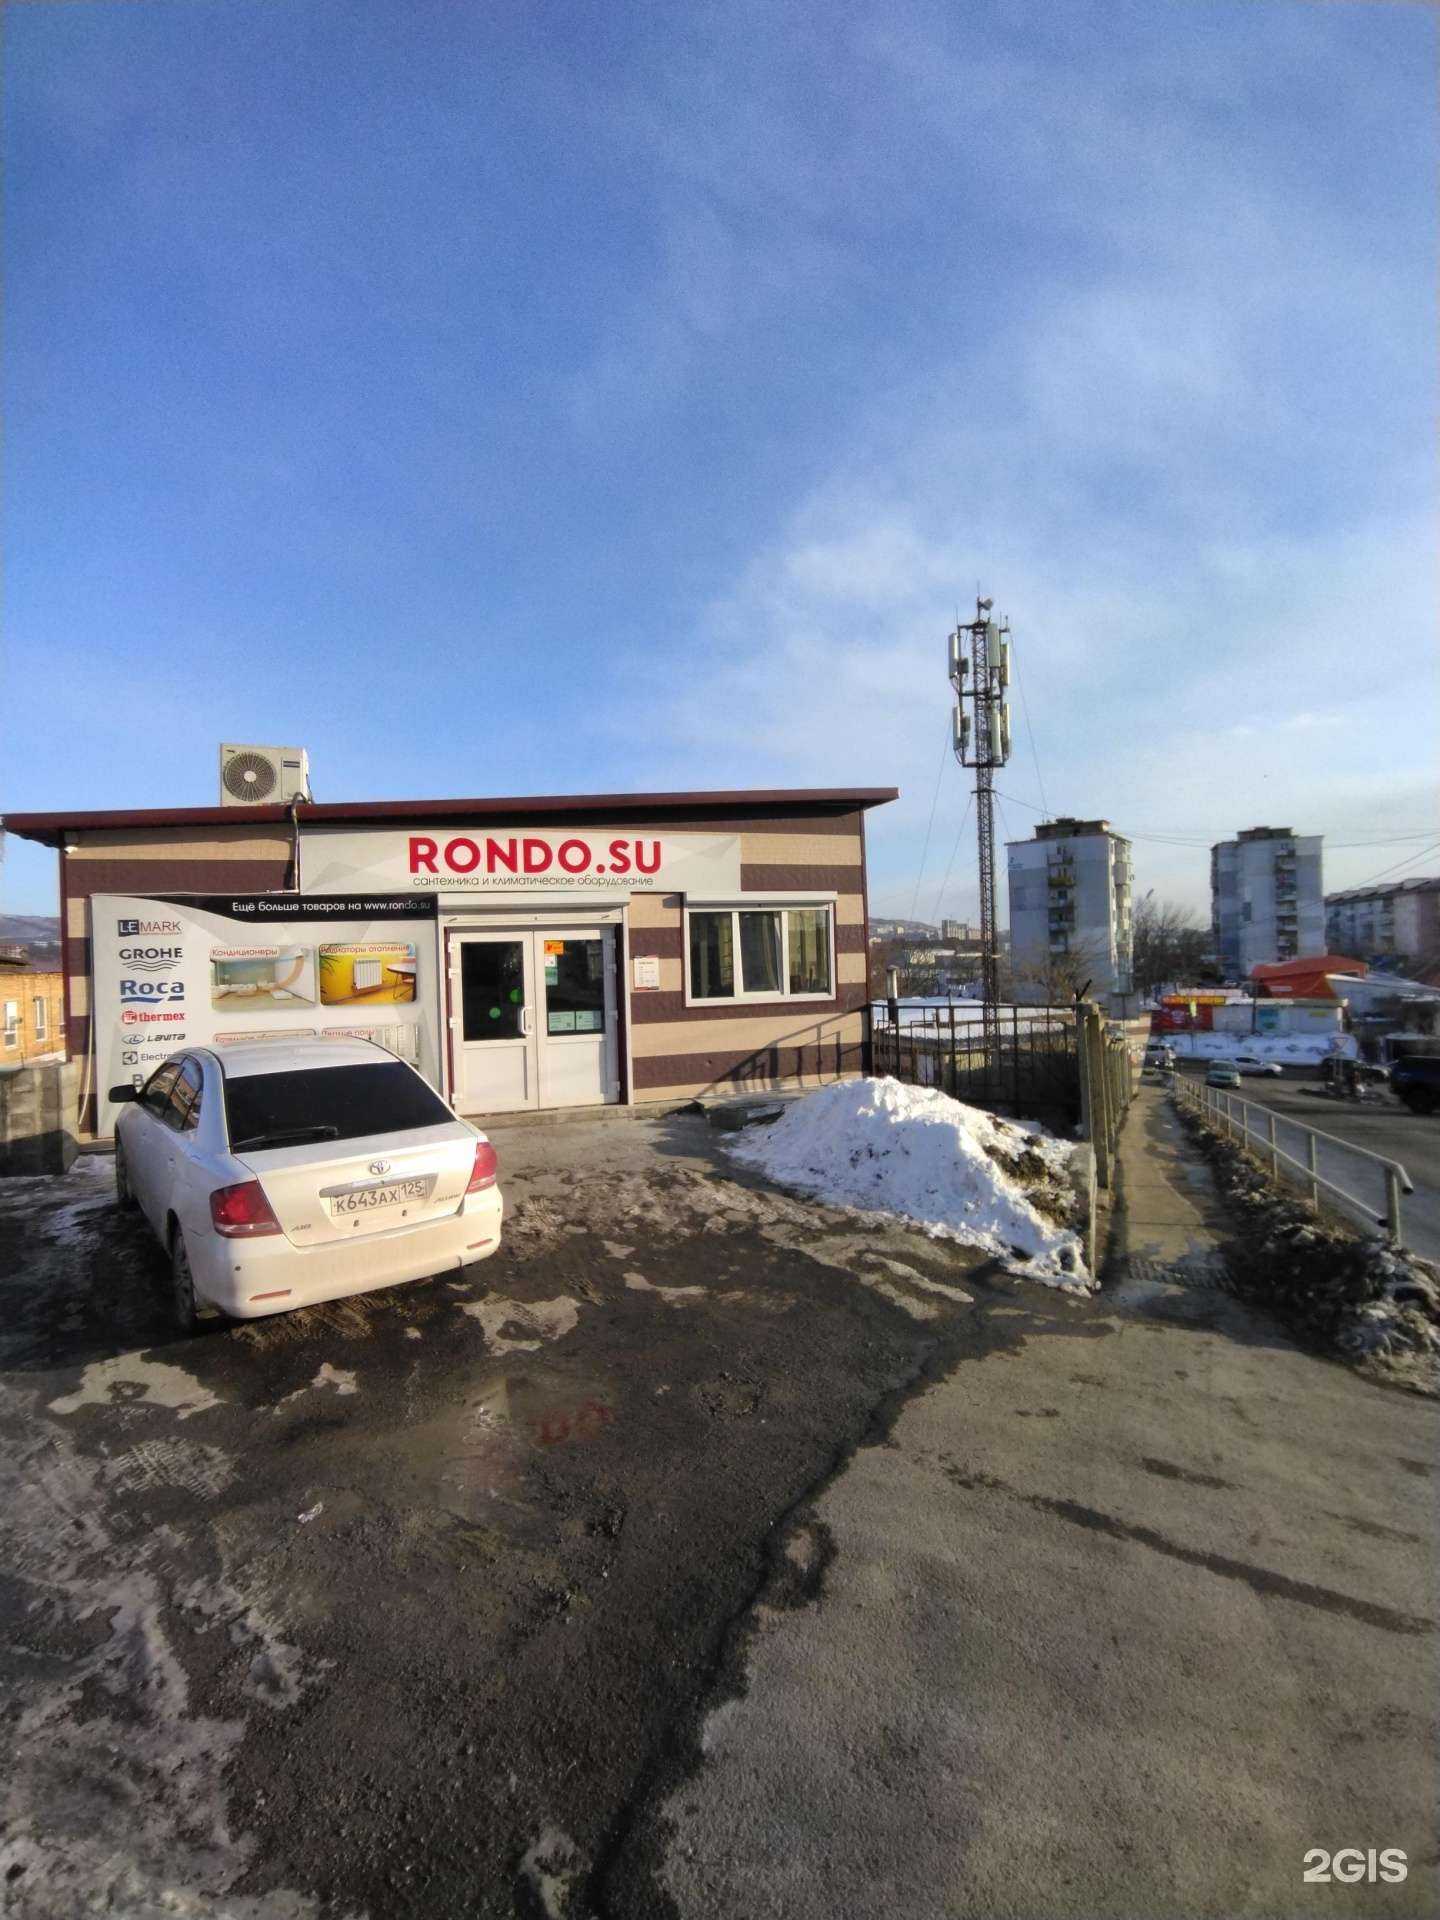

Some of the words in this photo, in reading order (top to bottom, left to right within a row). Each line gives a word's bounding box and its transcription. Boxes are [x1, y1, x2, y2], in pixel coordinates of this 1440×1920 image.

[409, 837, 661, 874] RONDO.SU
[413, 875, 479, 886] сантехника
[482, 876, 489, 886] и
[492, 876, 575, 886] климатическое
[577, 874, 654, 887] оборудование
[232, 901, 255, 912] Ещё
[258, 901, 299, 911] больше
[302, 902, 345, 912] товаров
[348, 902, 362, 911] на
[119, 948, 183, 959] GROHE
[211, 947, 278, 958] Кондиционеры
[120, 980, 185, 996] Roca
[139, 1012, 186, 1022] thermex
[400, 1181, 424, 1196] 125
